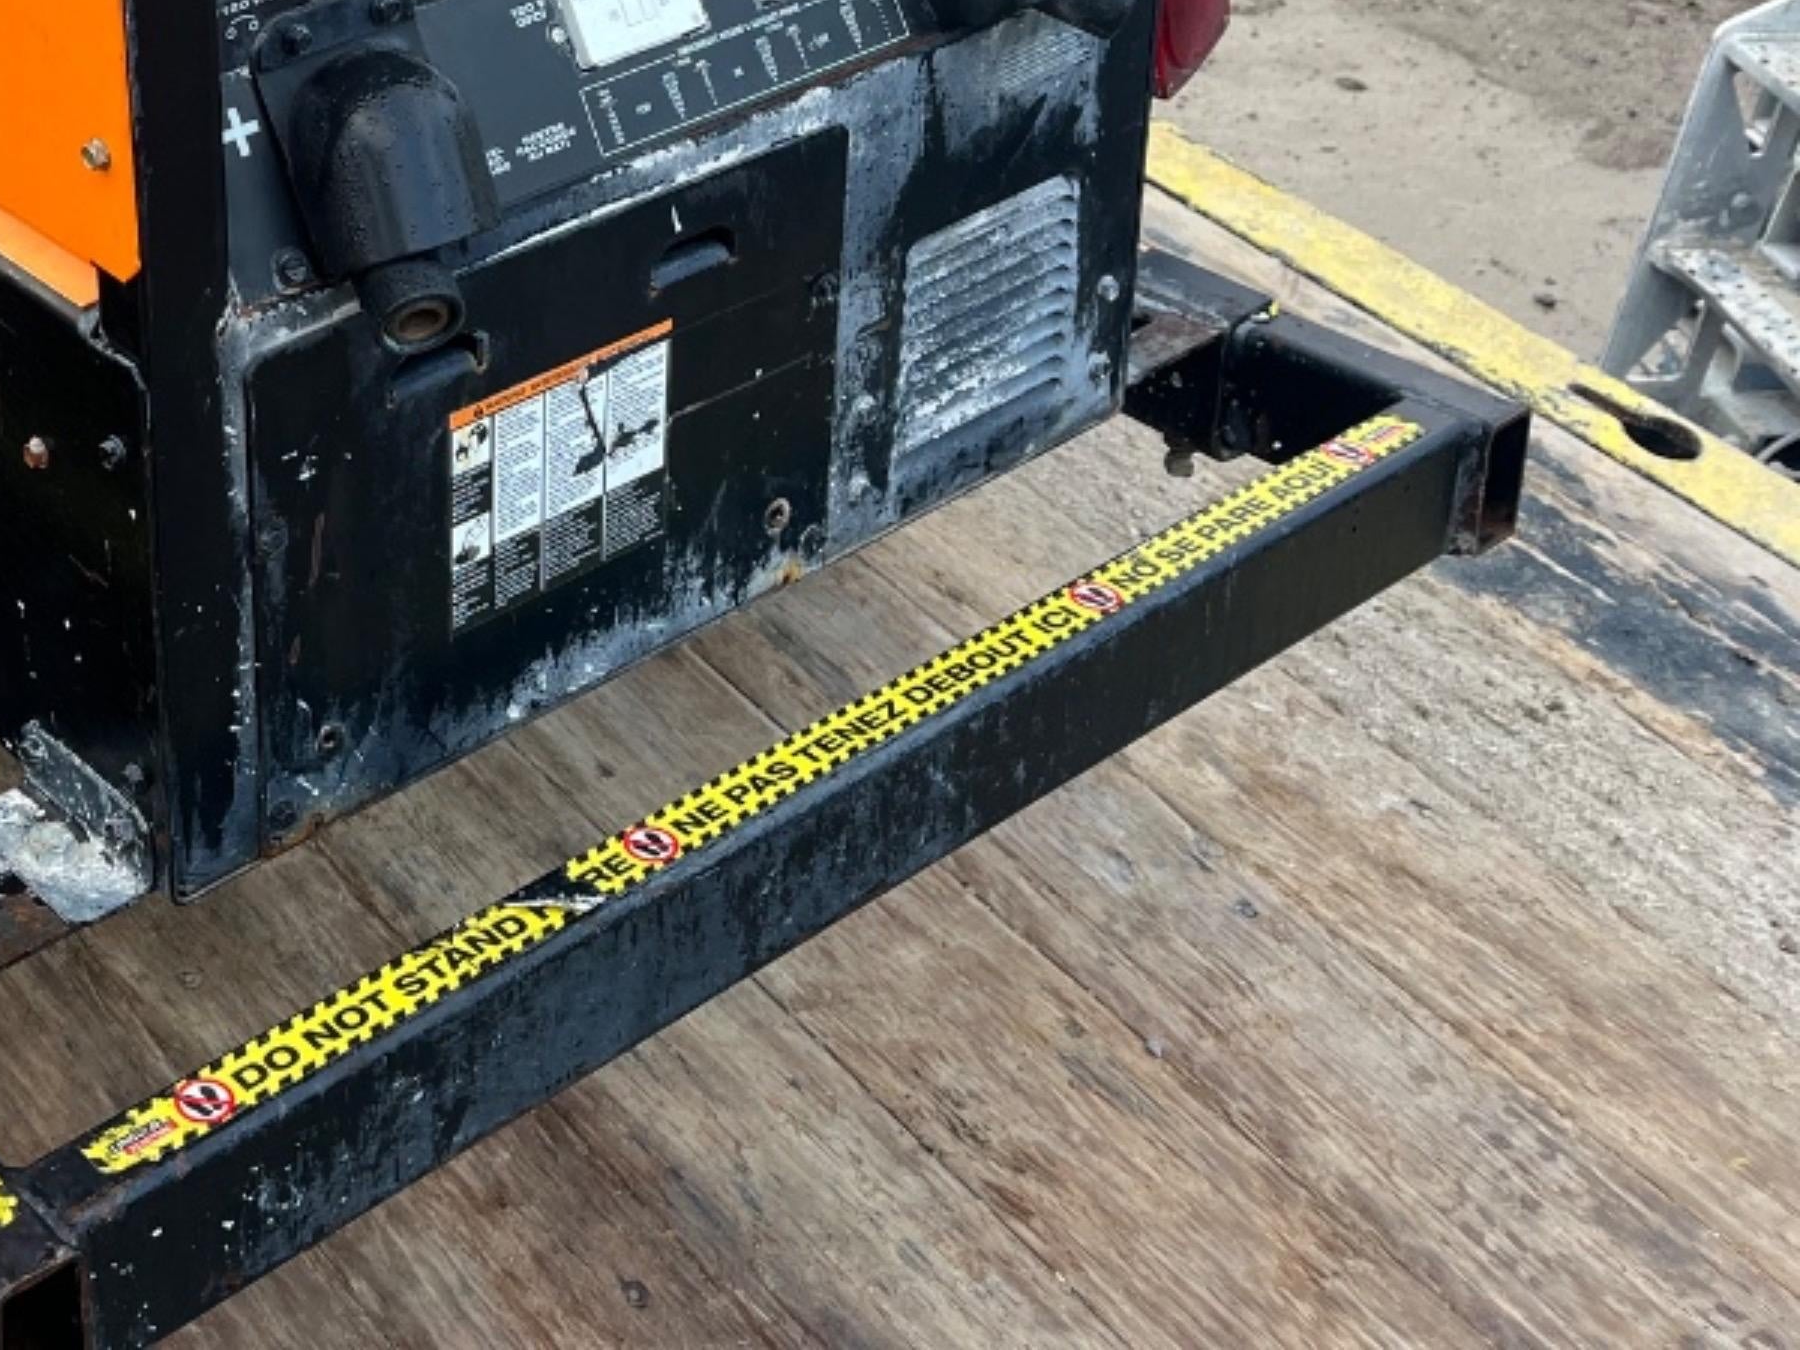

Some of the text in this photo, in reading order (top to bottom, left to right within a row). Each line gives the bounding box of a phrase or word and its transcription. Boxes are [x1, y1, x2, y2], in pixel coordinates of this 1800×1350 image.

[1111, 560, 1163, 589] NO
[1158, 535, 1203, 561] SE
[1196, 497, 1272, 542] PARE
[671, 605, 1086, 838] NE PAS TENEZ DEBOUT ICI
[233, 1045, 302, 1093] DO
[305, 987, 391, 1052] NOT
[398, 914, 529, 999] STAND
